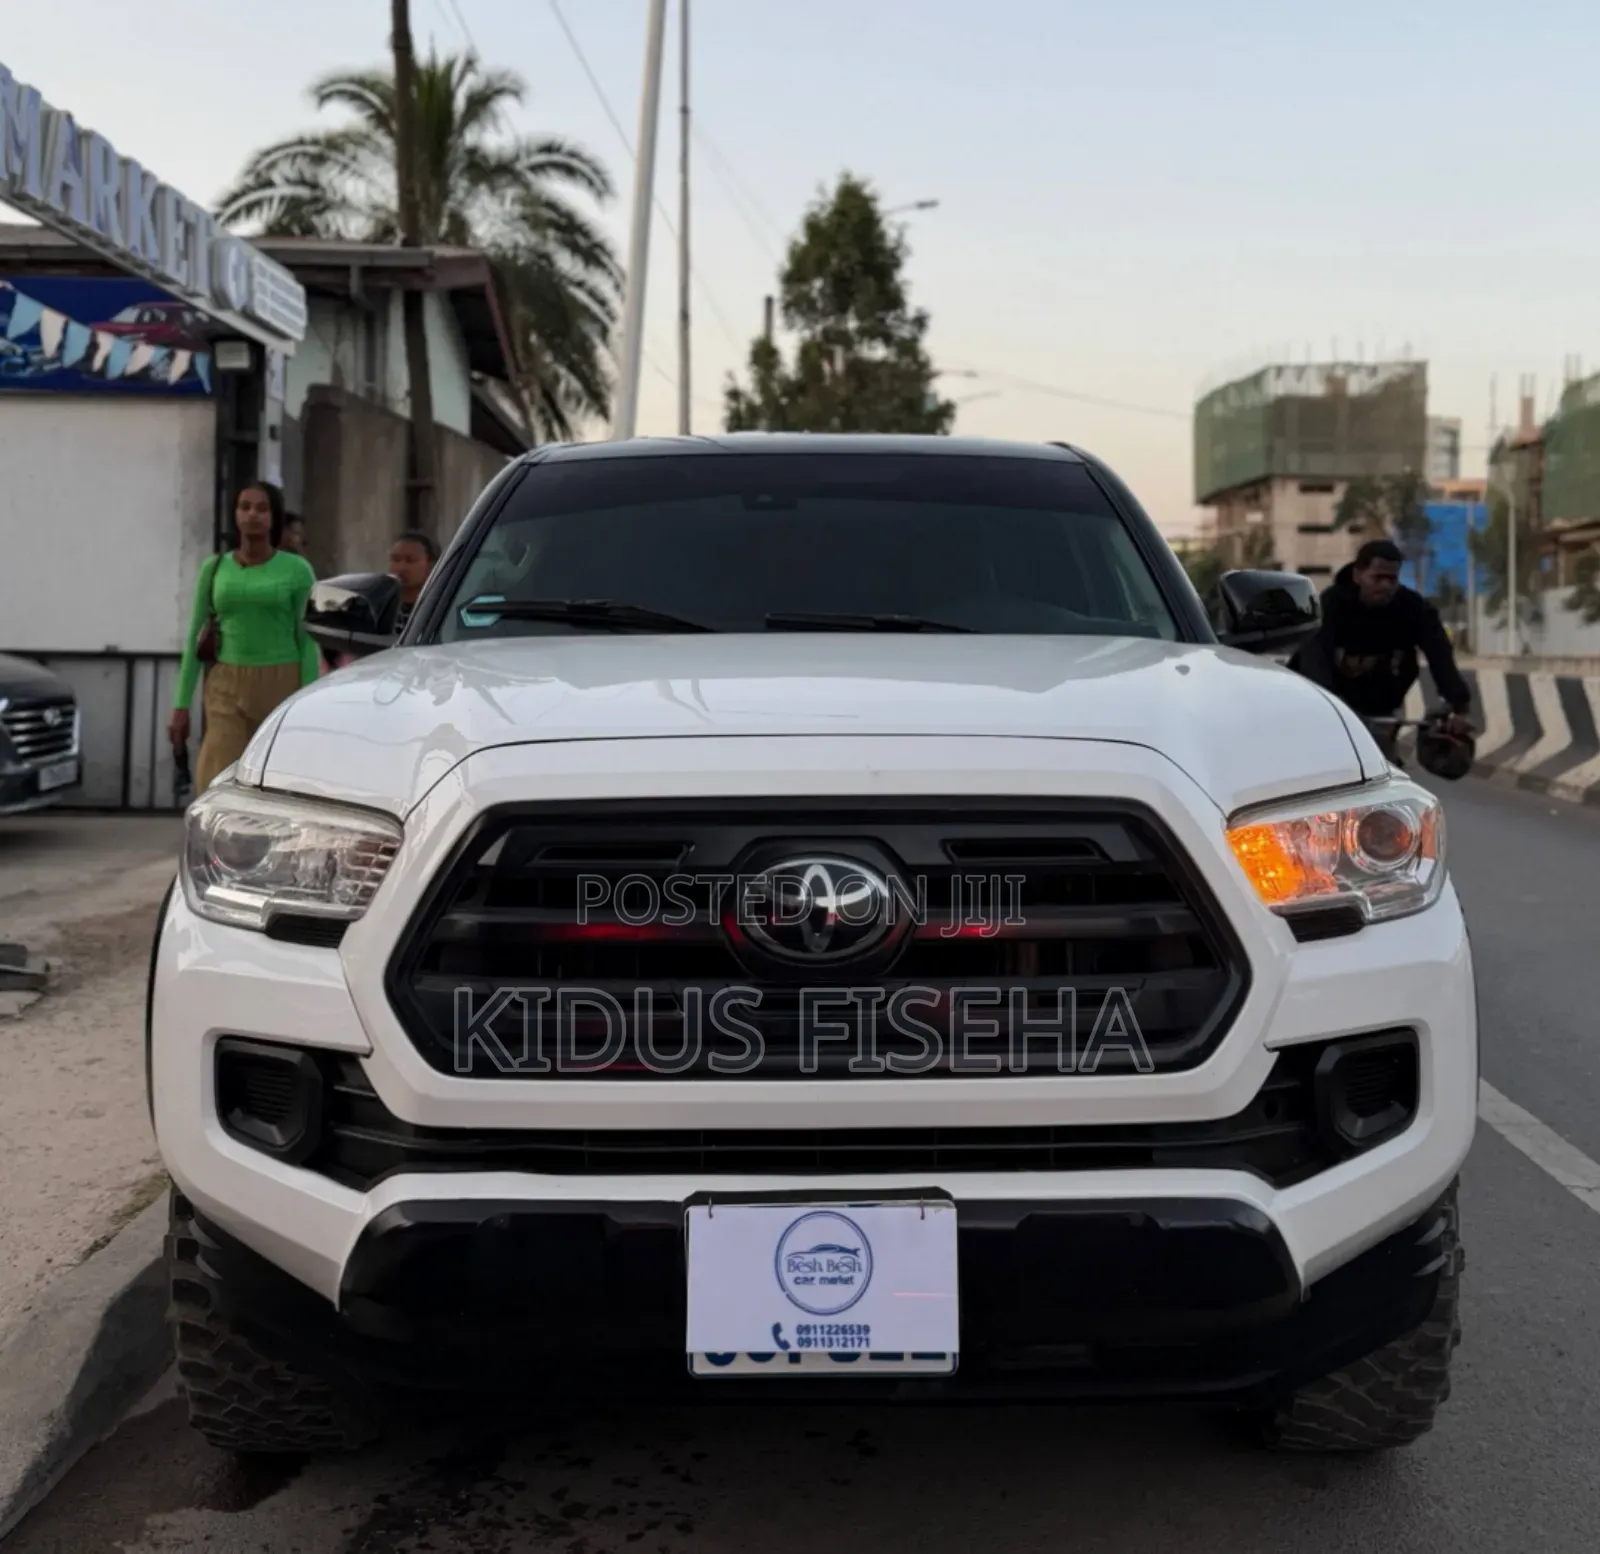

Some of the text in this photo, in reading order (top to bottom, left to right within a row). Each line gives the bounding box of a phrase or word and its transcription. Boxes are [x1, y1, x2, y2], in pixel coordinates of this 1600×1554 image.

[0, 62, 216, 299] MARKET
[787, 1257, 862, 1273] Besh Besh
[793, 1275, 815, 1286] car
[796, 1324, 870, 1336] 0911226539
[796, 1337, 870, 1349] 0911312171
